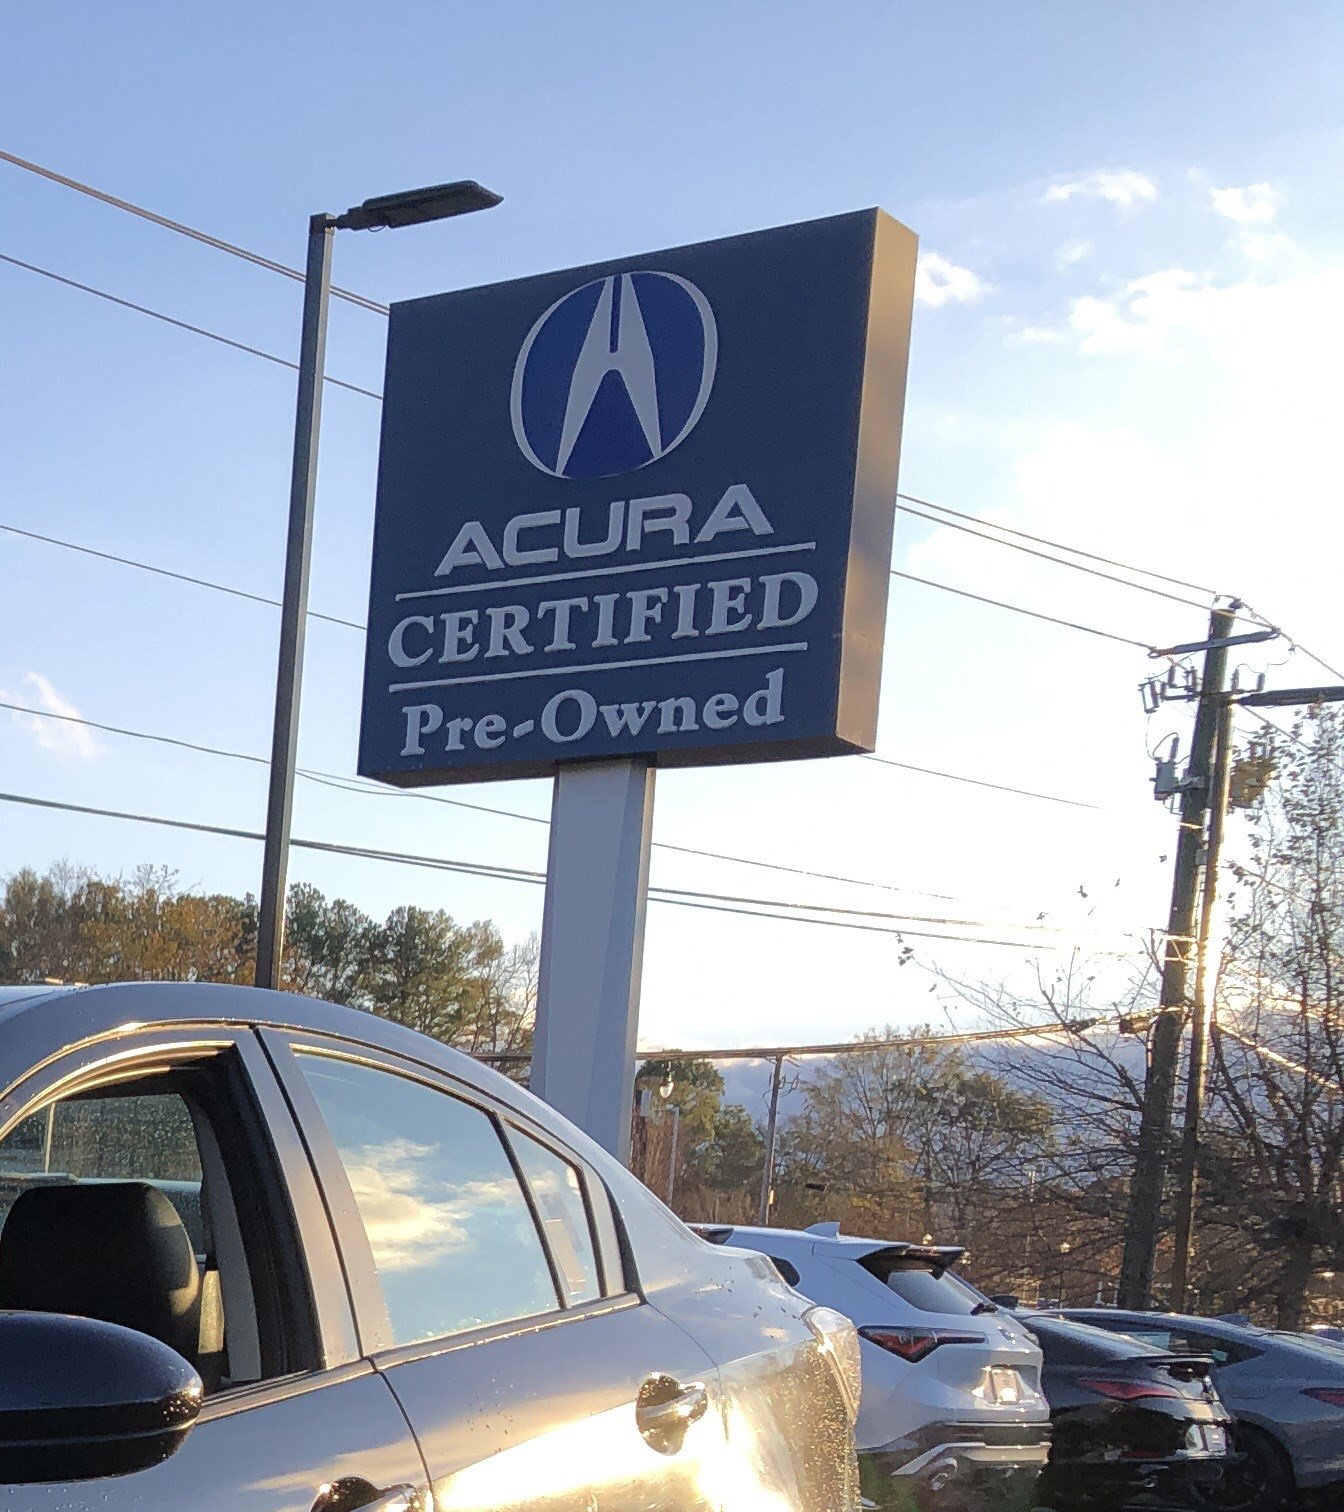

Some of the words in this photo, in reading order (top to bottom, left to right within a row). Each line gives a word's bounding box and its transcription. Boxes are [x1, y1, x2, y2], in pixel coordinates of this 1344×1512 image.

[433, 483, 775, 577] ACURA
[387, 570, 819, 669] CERTIFIED
[399, 666, 786, 757] Pre-Owned
